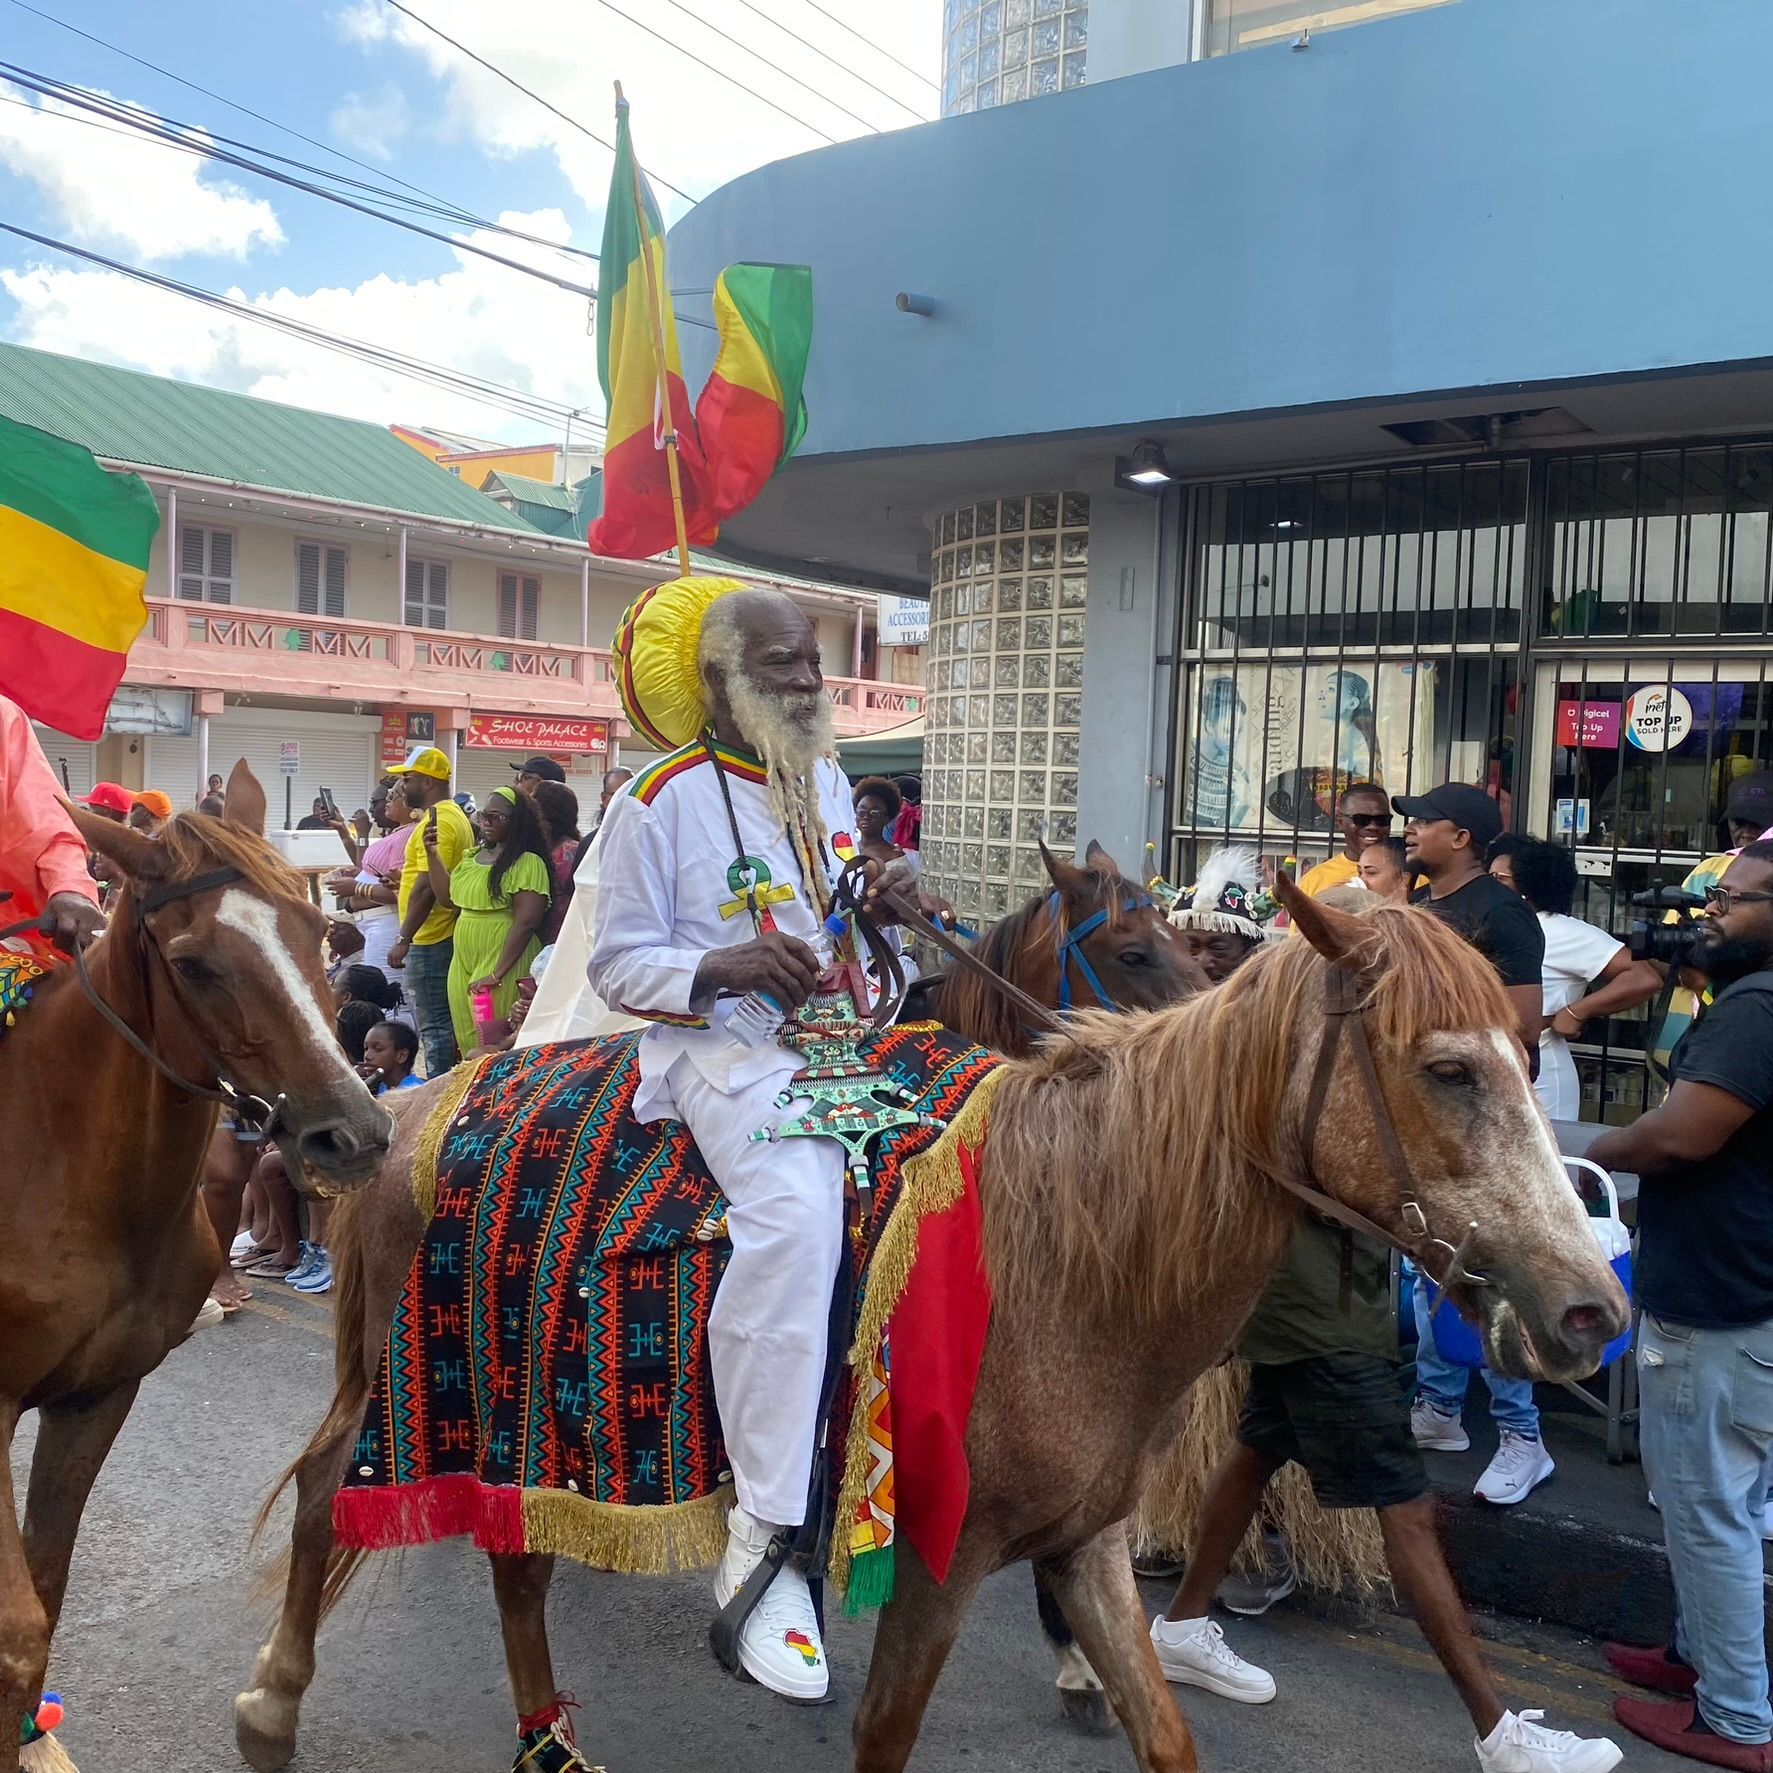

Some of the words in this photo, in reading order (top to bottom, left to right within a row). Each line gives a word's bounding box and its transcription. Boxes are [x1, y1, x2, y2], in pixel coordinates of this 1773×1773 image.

[1578, 708, 1610, 719] igicel
[1636, 717, 1662, 727] TOP
[488, 719, 534, 734] SHOE
[536, 722, 588, 738] PALACE
[1590, 723, 1603, 733] Up
[1636, 727, 1659, 735] SOLD
[493, 735, 525, 746] Footwear
[526, 737, 532, 746] &
[532, 738, 552, 748] Sports
[553, 740, 588, 749] Accessories
